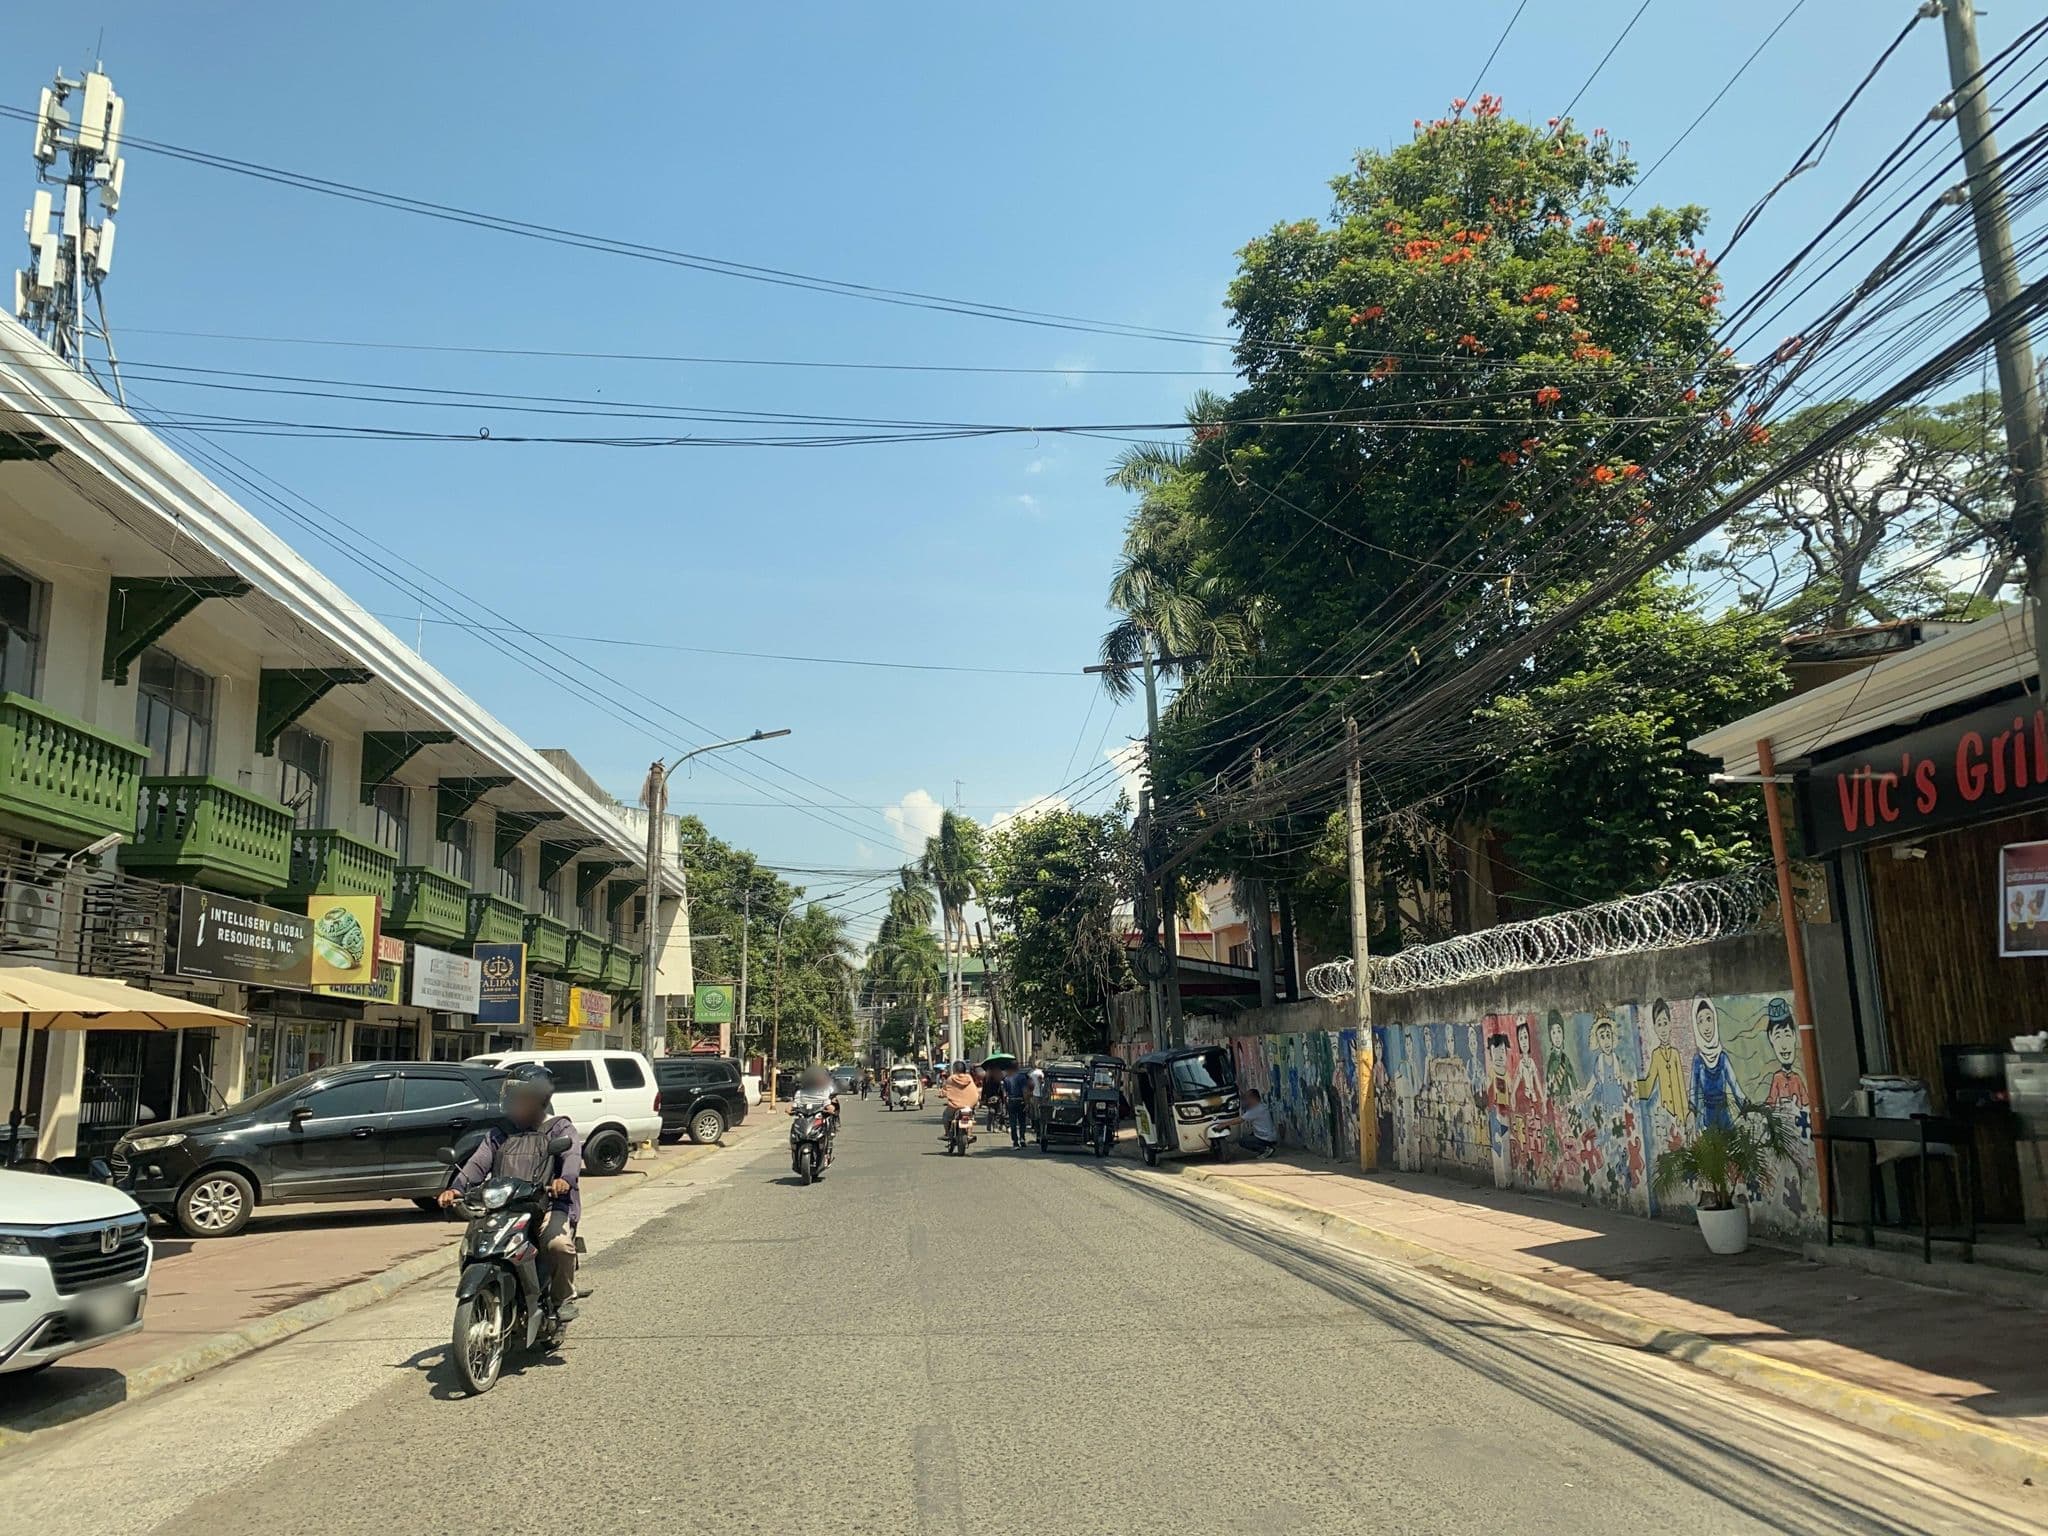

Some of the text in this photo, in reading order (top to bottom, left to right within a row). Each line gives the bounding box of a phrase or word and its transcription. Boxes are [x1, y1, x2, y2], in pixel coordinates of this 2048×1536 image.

[1837, 752, 1938, 832] Vic's
[210, 907, 304, 939] INTELLISERV GLOBAL
[217, 927, 294, 954] RESOURCES, INC.
[383, 938, 403, 961] RING
[367, 984, 388, 999] SHOP
